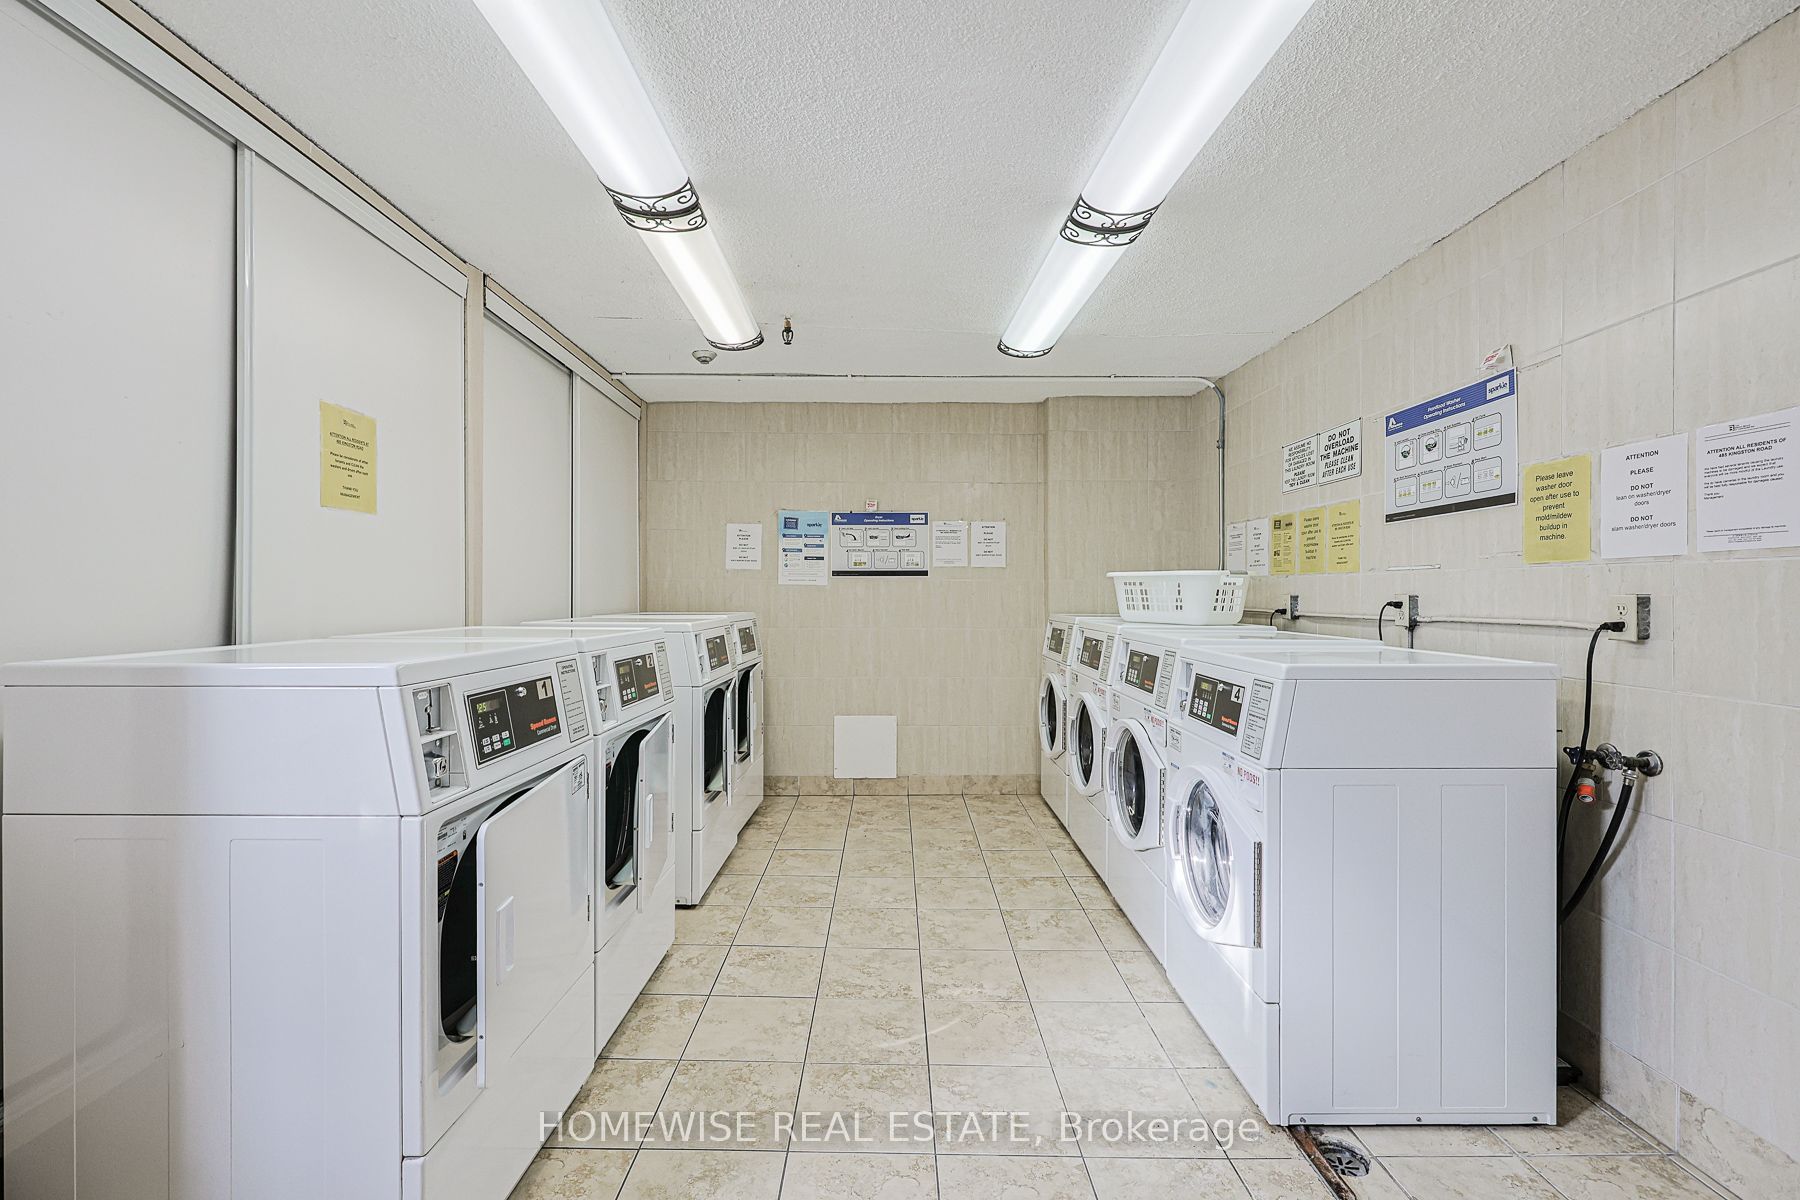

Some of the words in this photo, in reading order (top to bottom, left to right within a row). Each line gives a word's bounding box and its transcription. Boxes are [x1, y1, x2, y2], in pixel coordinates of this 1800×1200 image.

[1423, 410, 1442, 420] Operating
[1443, 402, 1466, 414] Instructions
[1328, 434, 1336, 442] DO
[1339, 428, 1351, 438] NOT
[1324, 436, 1354, 451] OVERLOAD
[1707, 446, 1734, 455] ATTENTION
[1747, 439, 1777, 448] RESIDENTS
[1320, 452, 1330, 461] THE
[1333, 443, 1359, 457] MACHINE
[1625, 450, 1659, 461] ATTENTION
[1325, 458, 1339, 469] PLEASE
[1340, 454, 1354, 464] CLEAN
[1322, 468, 1334, 478] AFTER
[1336, 465, 1347, 474] EACH
[1348, 462, 1356, 472] USE
[1630, 467, 1654, 476] PLEASE
[1535, 474, 1554, 482] Please
[1556, 470, 1574, 478] leave
[1535, 483, 1557, 492] washer
[1530, 495, 1544, 503] open
[1545, 492, 1558, 500] after
[1636, 488, 1672, 499] washer/dryer
[1542, 502, 1565, 512] prevent
[1535, 512, 1573, 521] mold/mildew
[1539, 523, 1560, 532] buildup
[1624, 522, 1659, 532] washer/dryer
[1540, 533, 1566, 541] machine.
[648, 656, 652, 666] 2
[541, 680, 548, 697] 1
[1234, 688, 1241, 701] 4
[1237, 766, 1243, 775] NO
